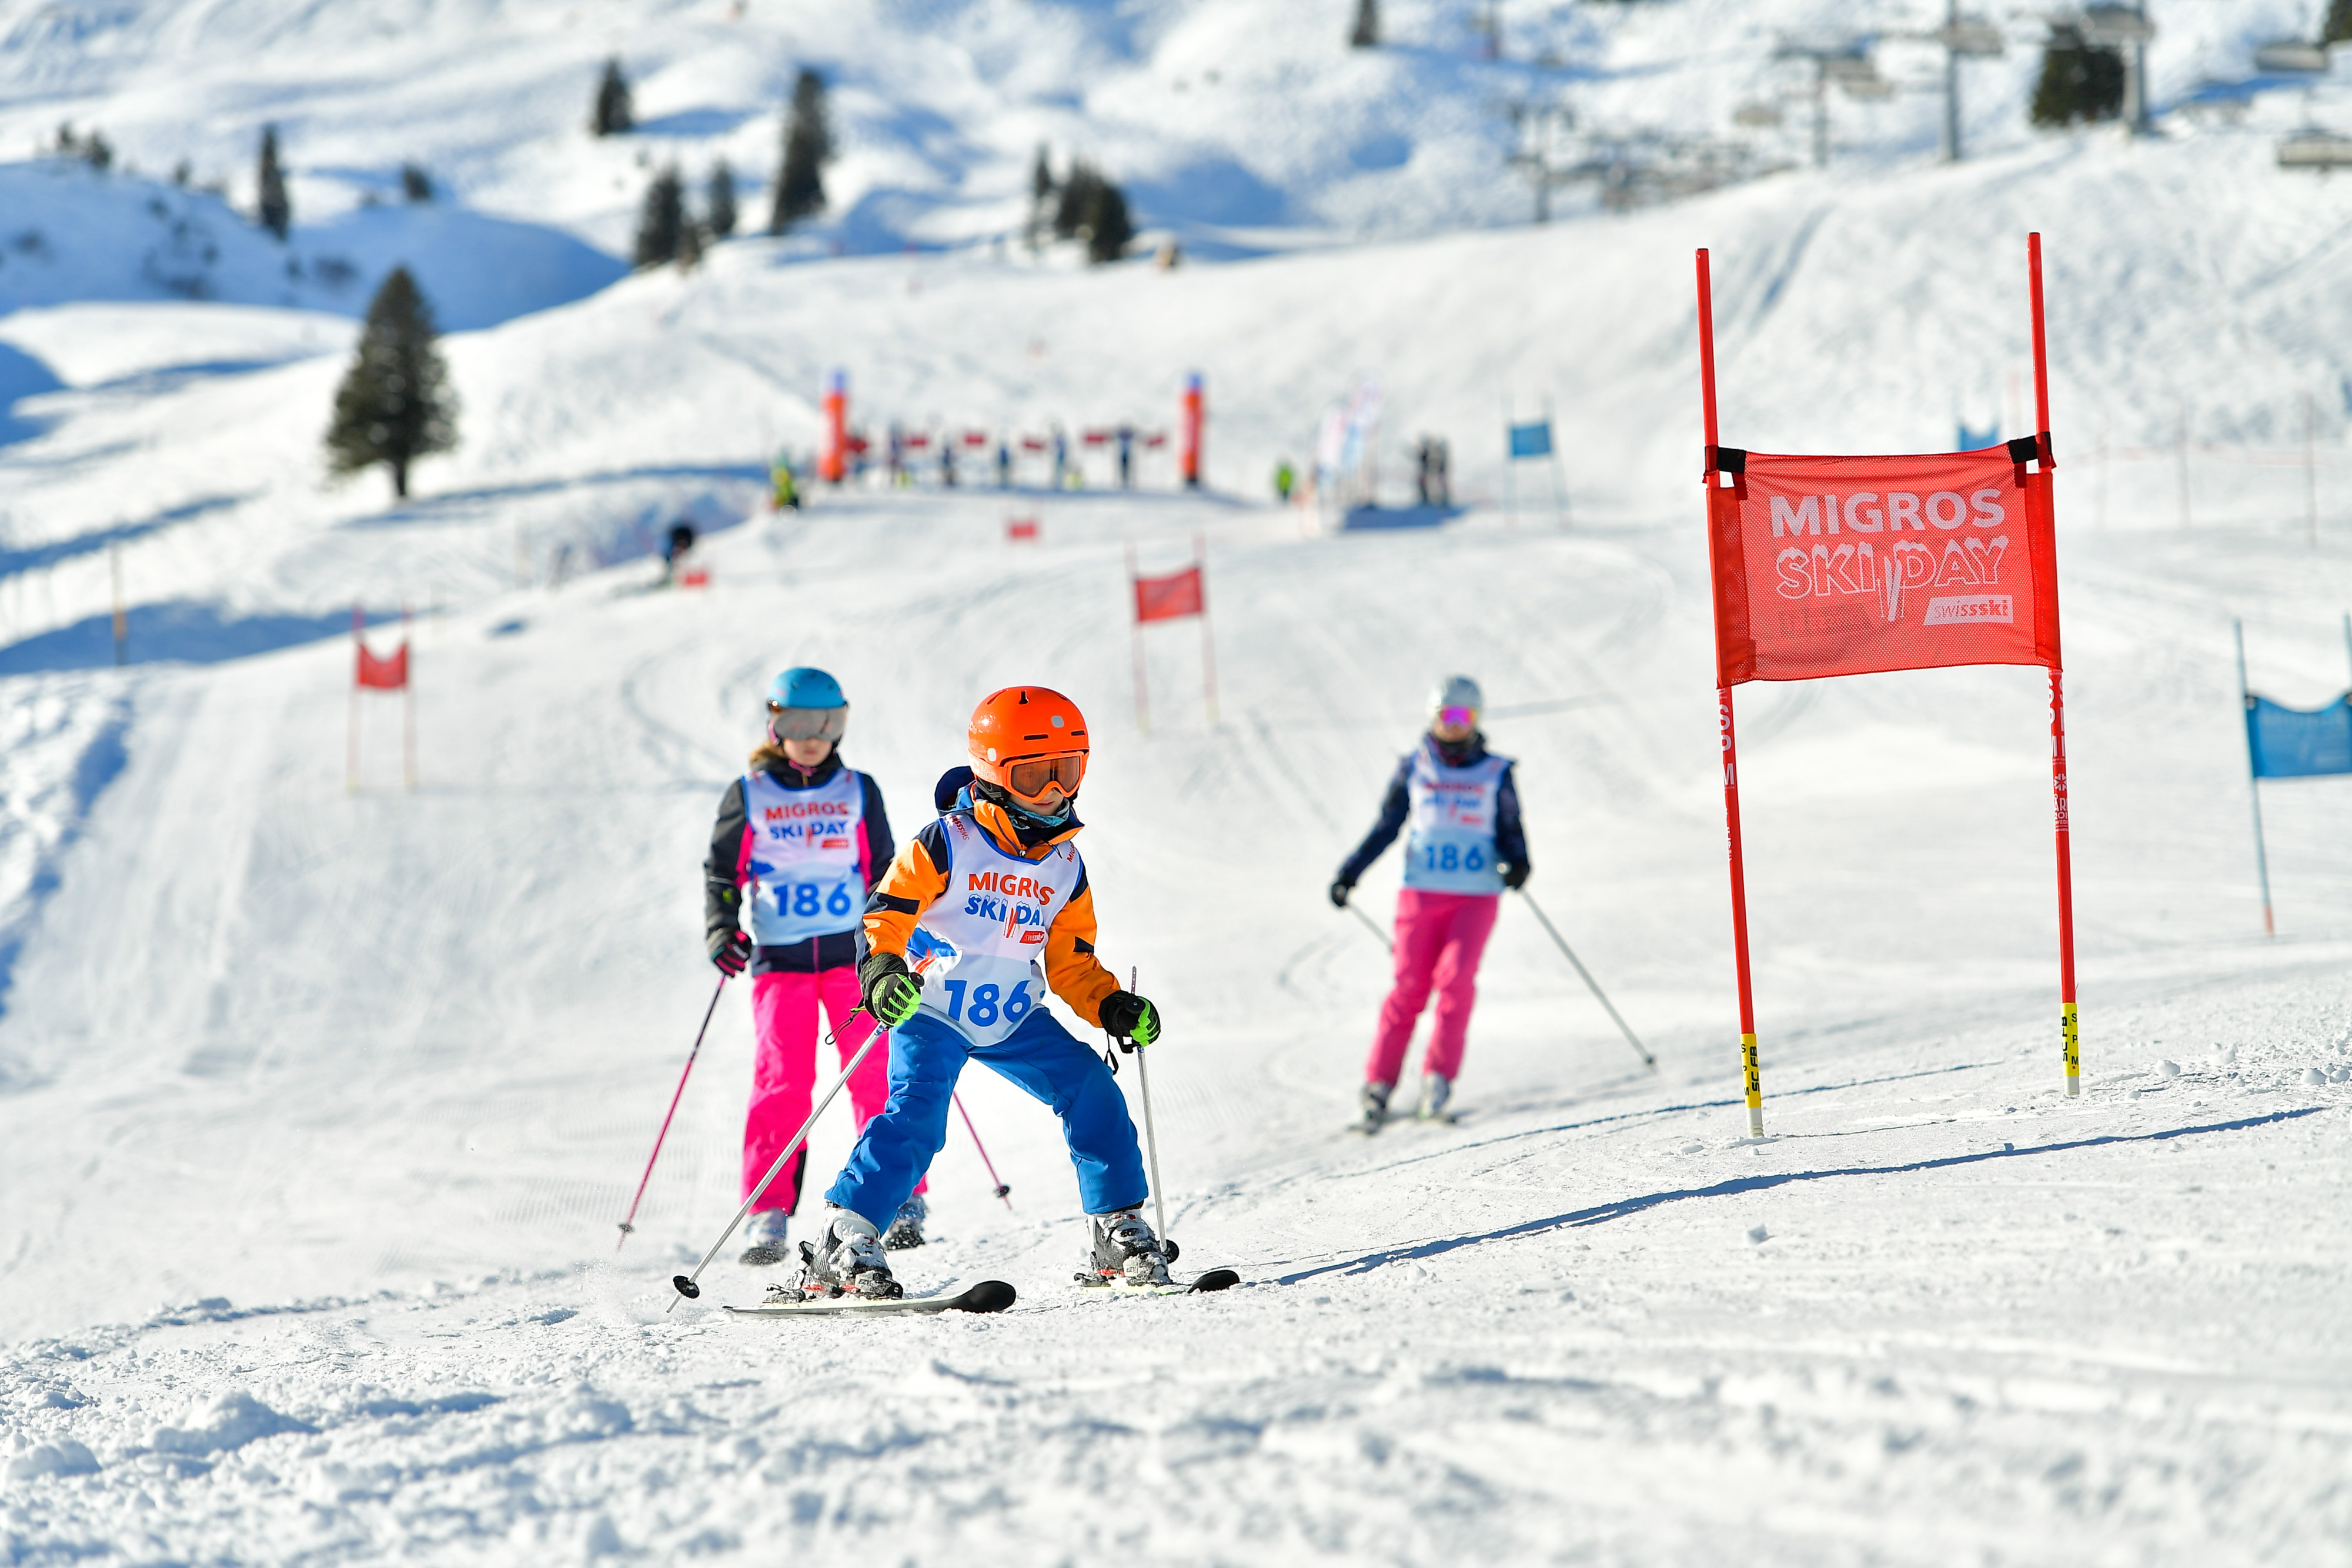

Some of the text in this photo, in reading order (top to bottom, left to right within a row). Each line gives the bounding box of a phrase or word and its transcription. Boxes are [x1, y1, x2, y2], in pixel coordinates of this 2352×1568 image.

[1770, 489, 2005, 537] MIGROS
[1776, 536, 2009, 600] SKI DAY
[1935, 600, 2008, 618] swissski
[766, 802, 848, 821] MIGROS
[770, 821, 847, 839] SKI DAY
[1426, 844, 1484, 871] 186
[773, 882, 850, 916] 186
[964, 894, 1044, 926] SKI DA
[945, 980, 1031, 1027] 186
